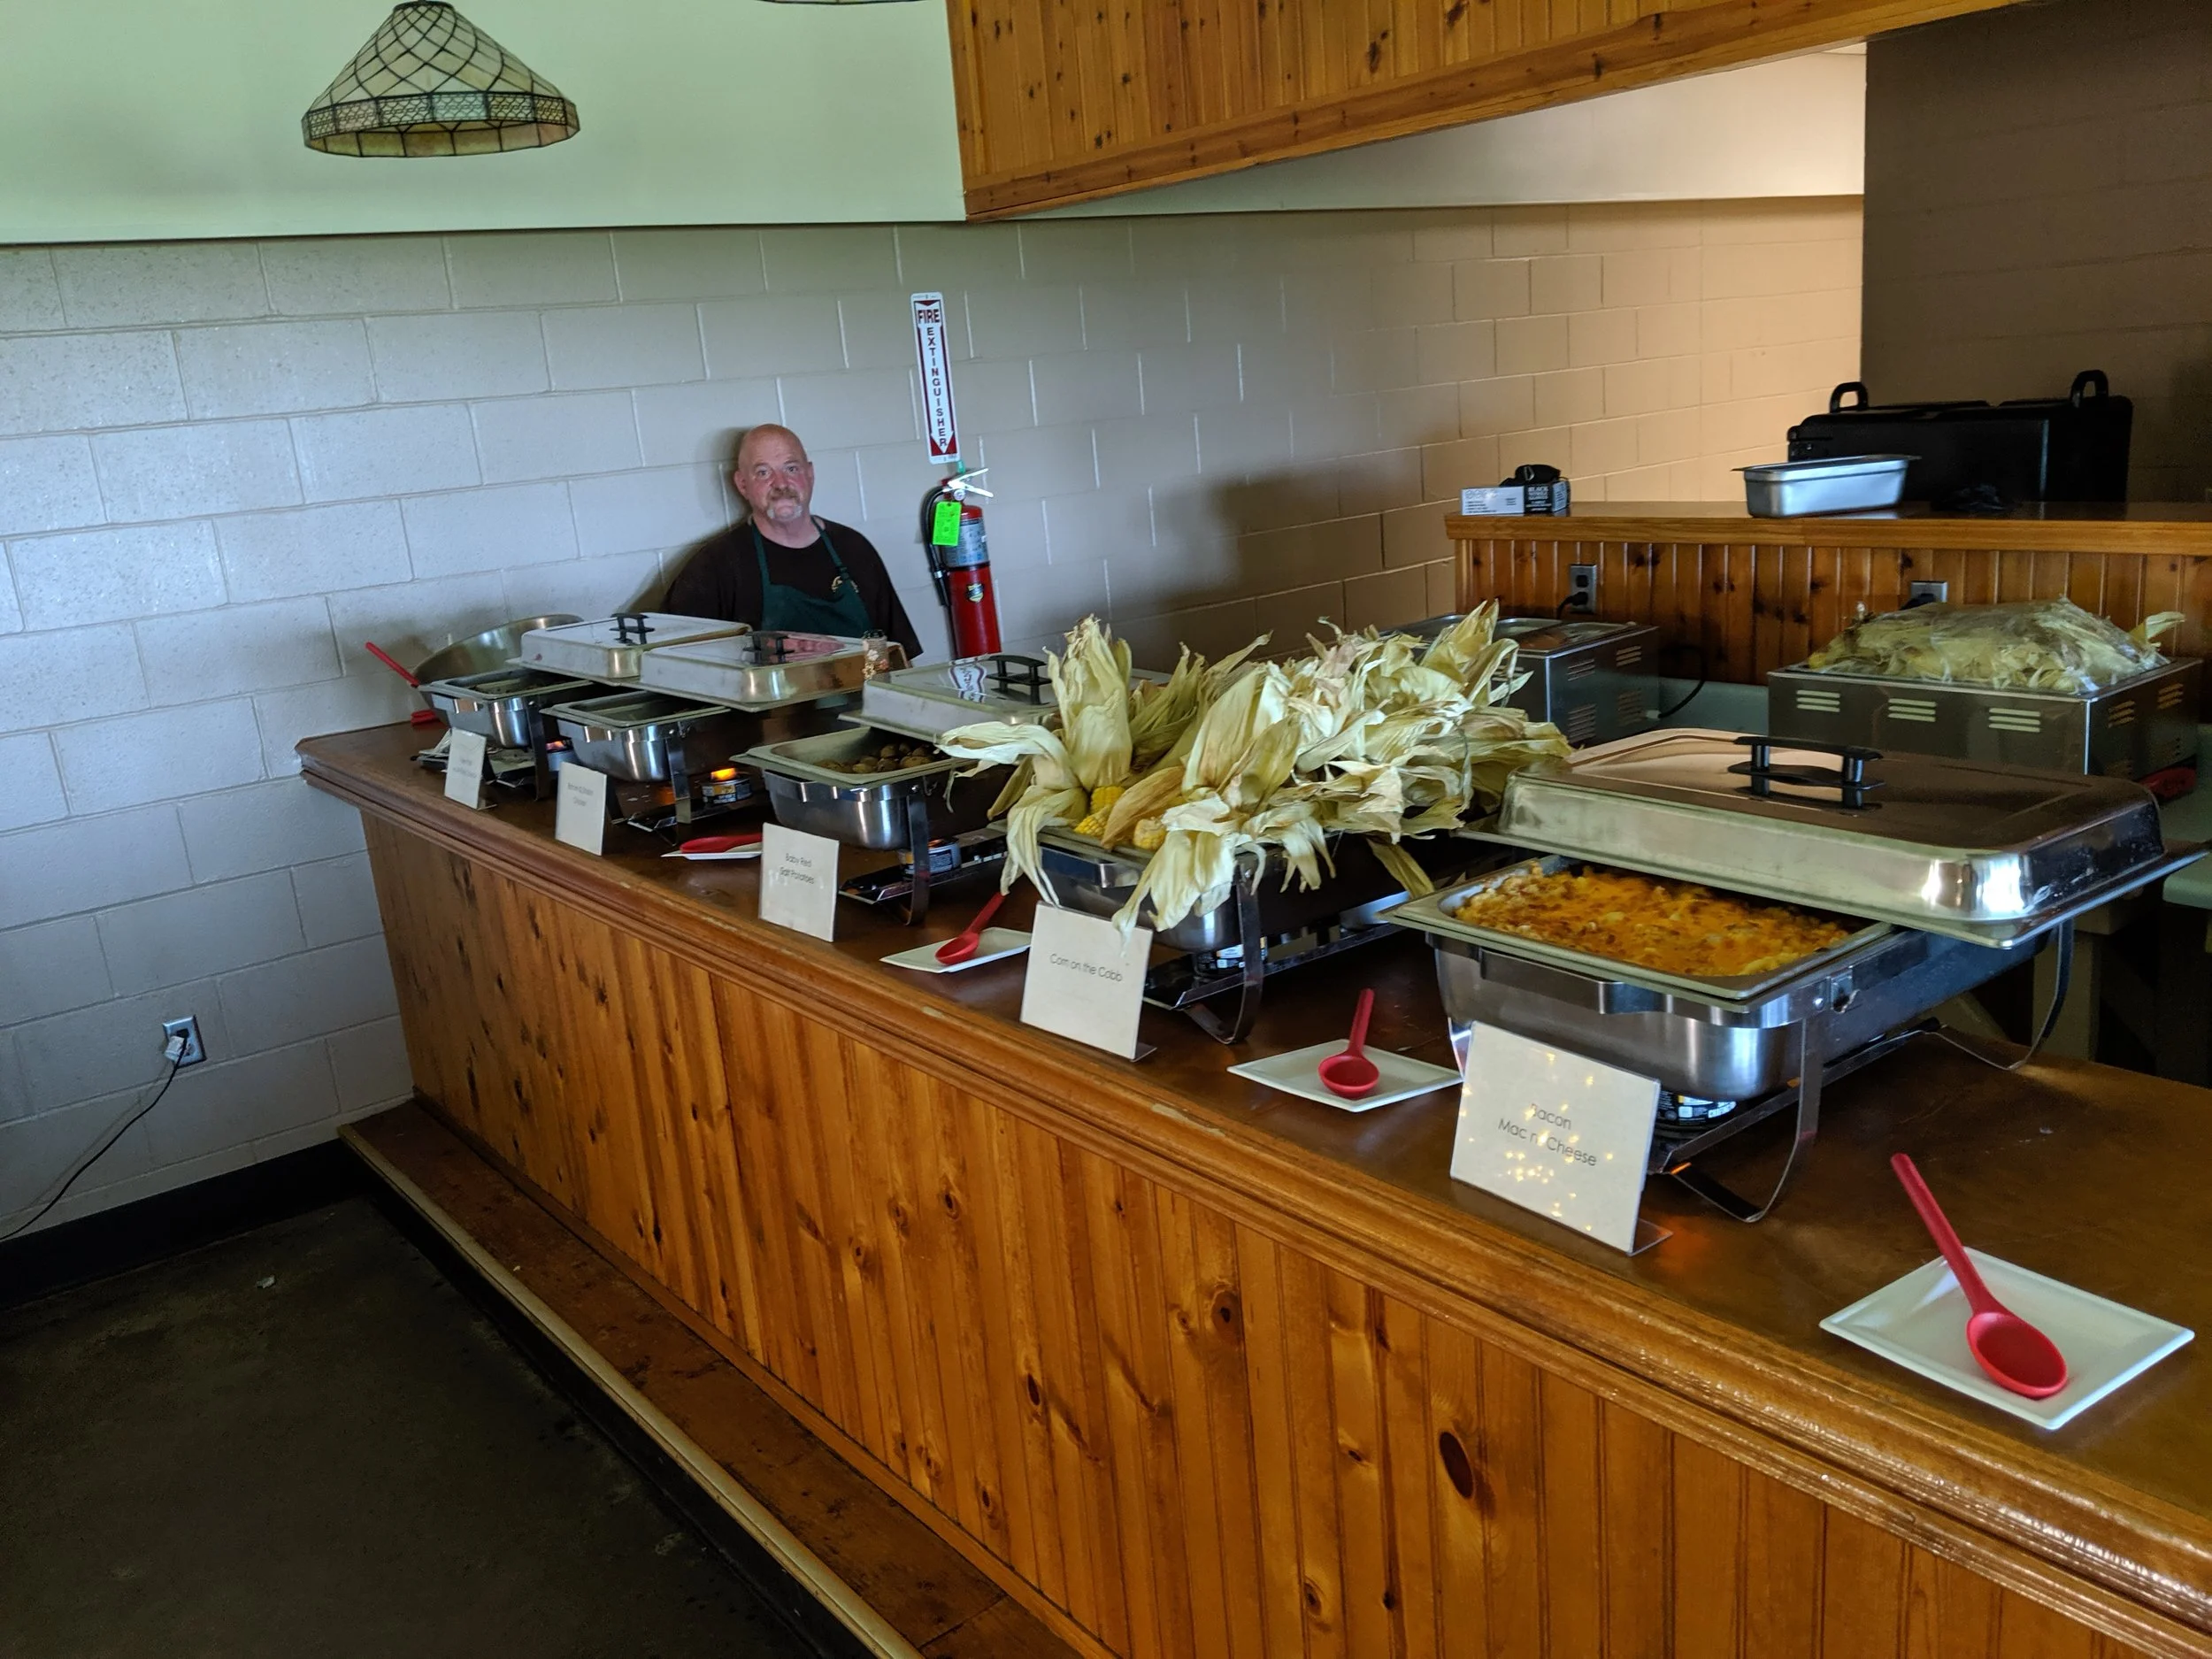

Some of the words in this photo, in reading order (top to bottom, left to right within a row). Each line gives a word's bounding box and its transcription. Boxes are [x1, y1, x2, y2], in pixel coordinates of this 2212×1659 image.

[917, 309, 941, 324] FIRE
[926, 326, 948, 446] EXTINGUISHER
[1071, 961, 1081, 971] on
[1083, 963, 1097, 975] the
[1098, 966, 1123, 982] Cobb
[1498, 1118, 1527, 1139] Mac
[1547, 1136, 1597, 1166] Cheese
